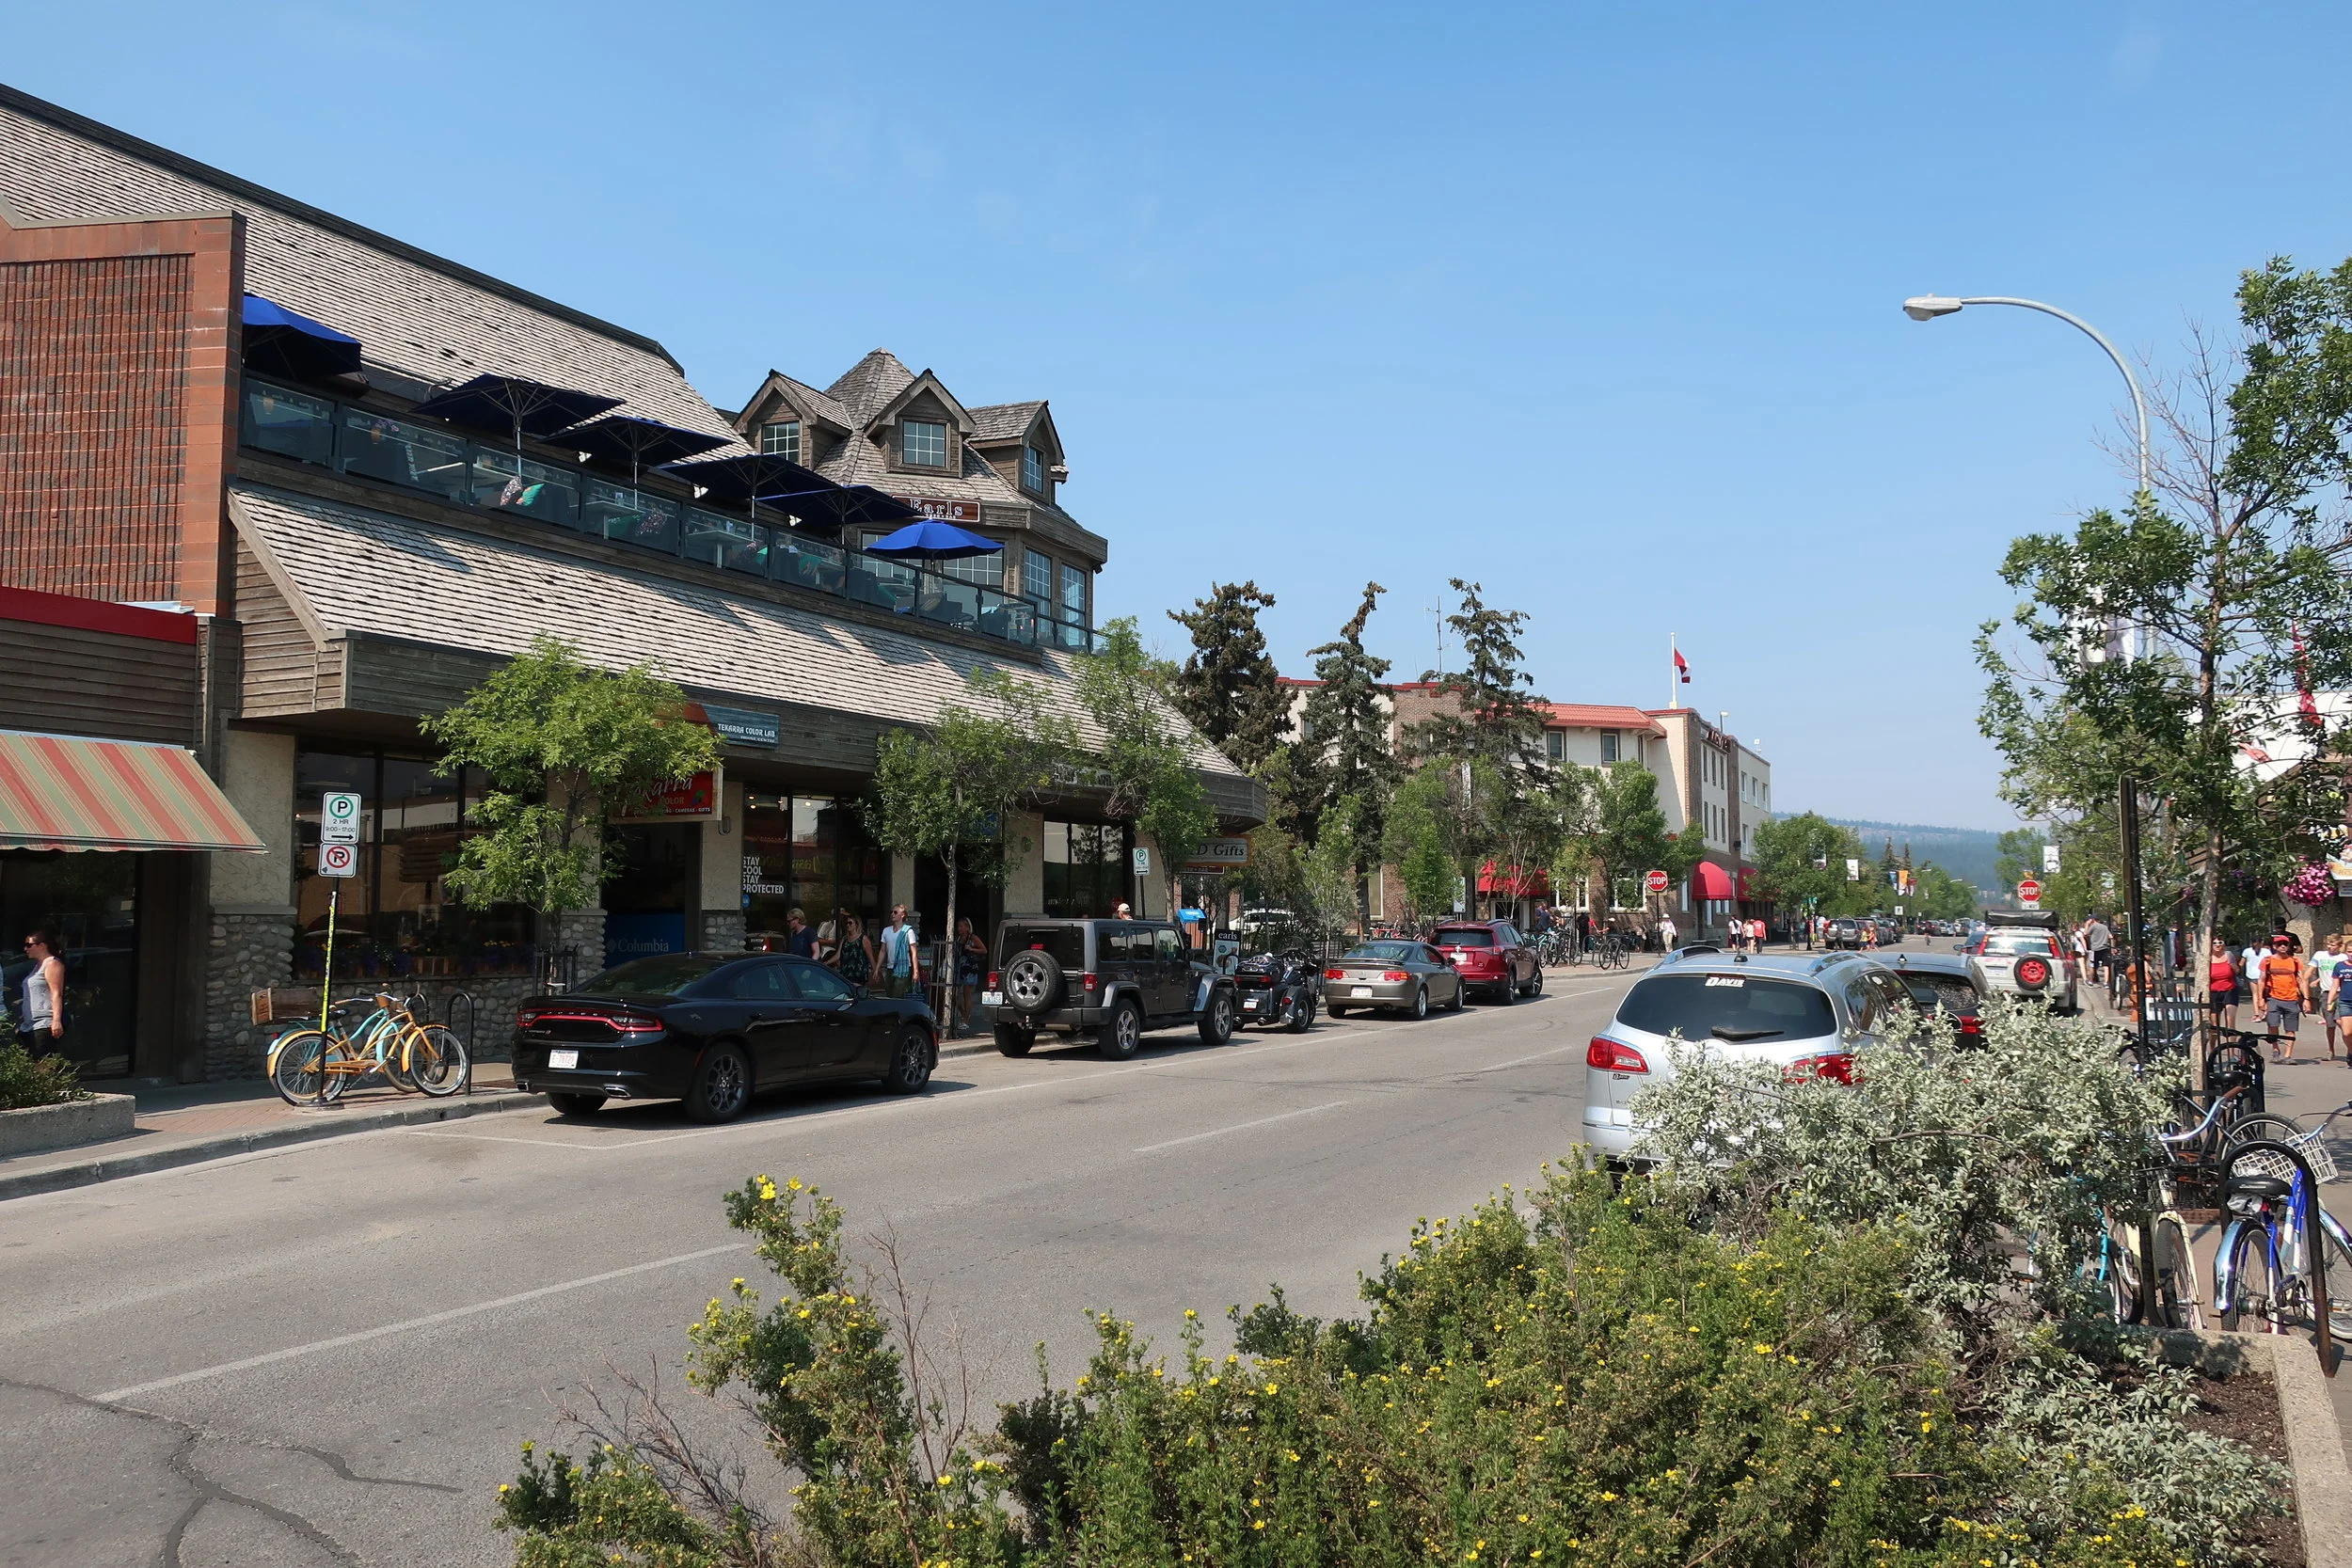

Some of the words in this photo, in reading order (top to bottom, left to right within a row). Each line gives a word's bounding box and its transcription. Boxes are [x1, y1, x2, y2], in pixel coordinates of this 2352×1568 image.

[910, 499, 962, 516] Earls
[717, 723, 744, 734] TEKARRA
[745, 727, 763, 736] COLOR
[338, 801, 348, 813] P
[1214, 844, 1245, 856] Gifts
[1648, 877, 1666, 885] STOP
[742, 884, 785, 895] PROTECTED
[1217, 931, 1238, 940] earls
[618, 938, 669, 952] Columbia
